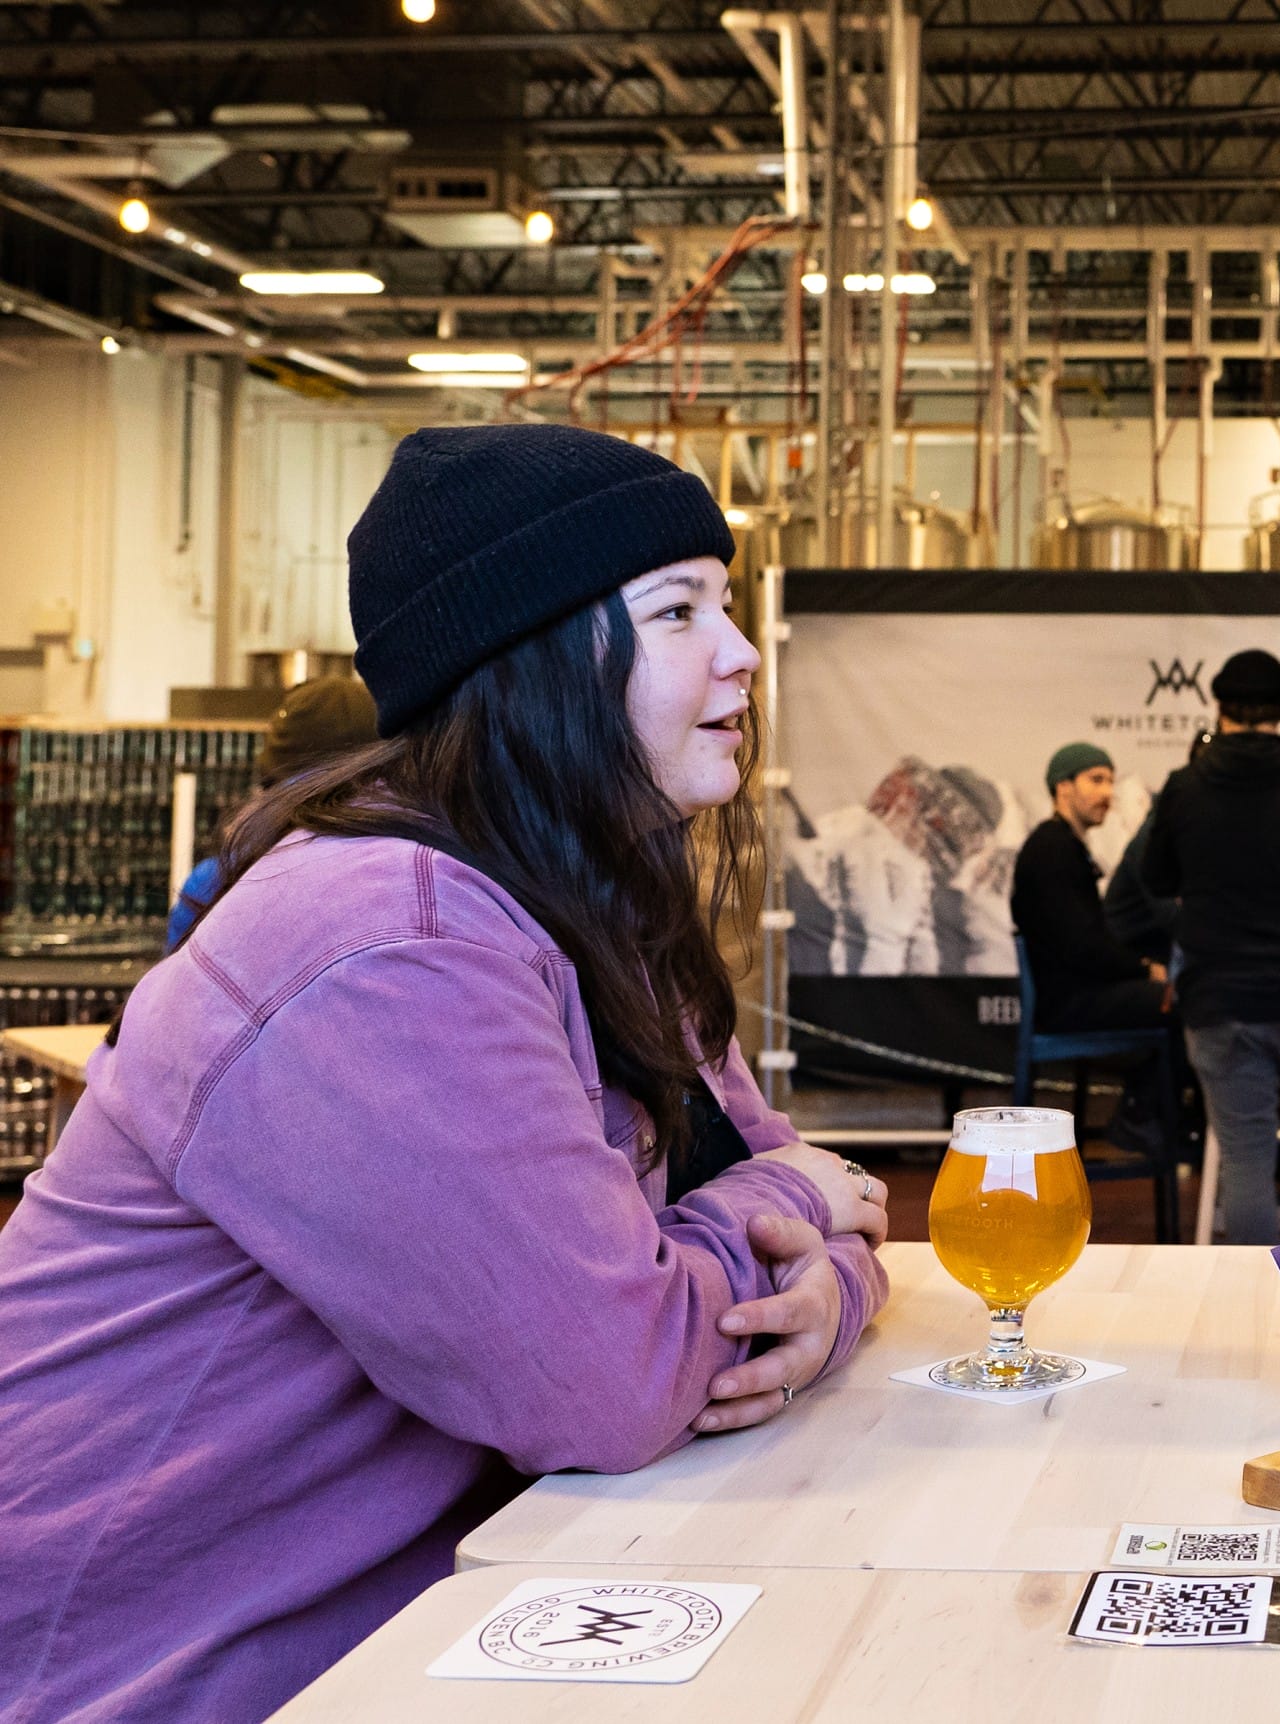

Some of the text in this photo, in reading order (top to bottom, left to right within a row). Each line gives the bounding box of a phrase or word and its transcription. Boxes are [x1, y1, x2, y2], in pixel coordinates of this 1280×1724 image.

[487, 1597, 561, 1654] GOLDEN BC
[522, 1611, 561, 1638] 2016
[592, 1587, 715, 1630] WHITETOOTH
[568, 1633, 702, 1669] BREWING
